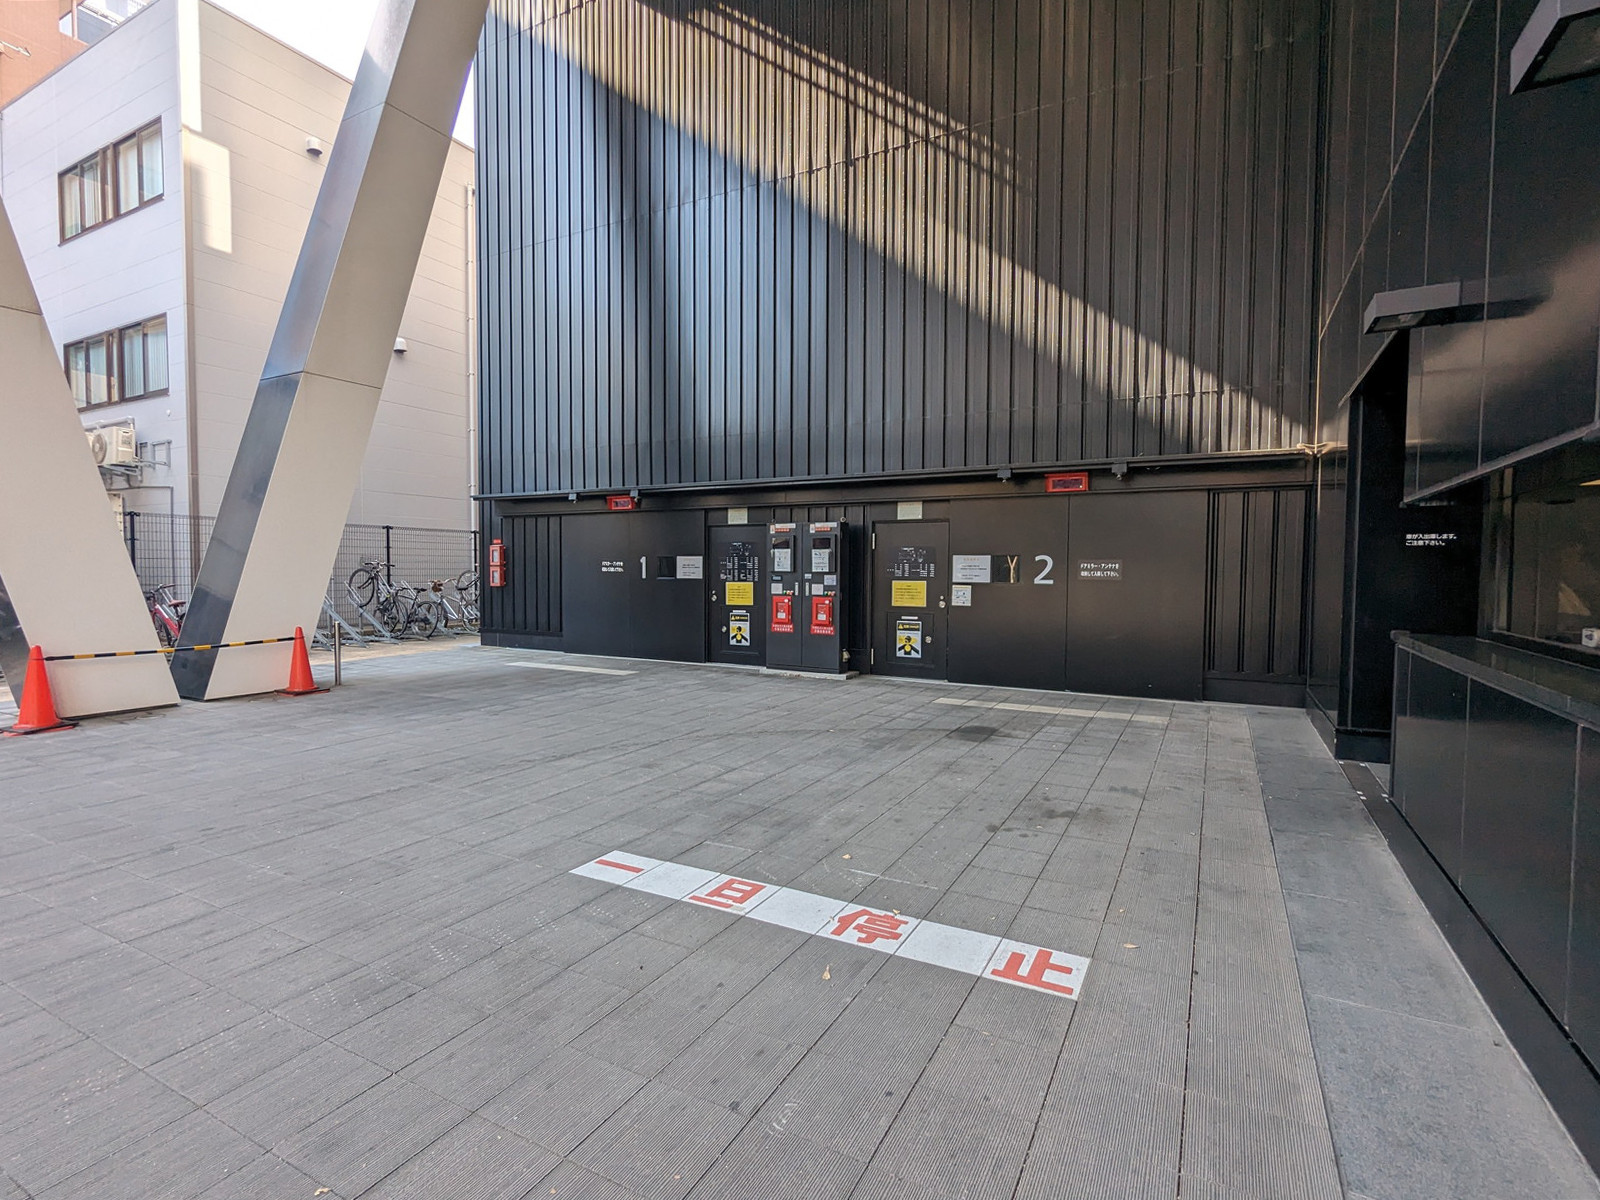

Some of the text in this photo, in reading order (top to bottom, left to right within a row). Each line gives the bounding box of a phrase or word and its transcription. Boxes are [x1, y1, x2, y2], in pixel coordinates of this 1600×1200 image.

[640, 556, 647, 579] 1
[1033, 555, 1054, 585] 2
[594, 858, 1074, 996] 一旦停止
